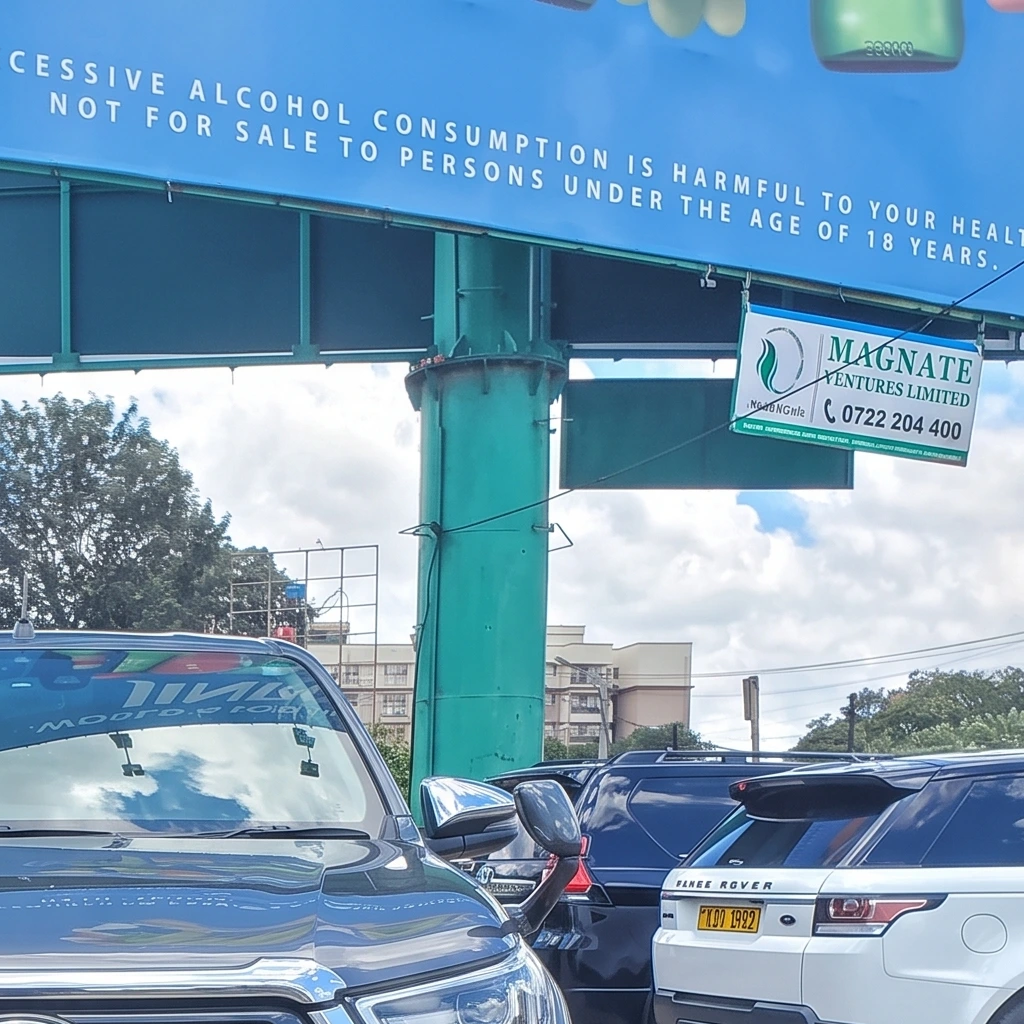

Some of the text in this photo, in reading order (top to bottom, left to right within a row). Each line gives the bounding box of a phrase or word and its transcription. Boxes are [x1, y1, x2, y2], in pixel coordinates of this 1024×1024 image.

[189, 79, 351, 125] ALCOHOL
[373, 109, 608, 170] CONSUMPTION
[628, 154, 654, 178] IS
[673, 162, 805, 207] HARMFUL
[821, 191, 853, 215] TO
[868, 199, 936, 230] YOUR
[50, 91, 998, 271] NOT FOR SALE TO PERSONS UNDER THE AGE OF 18 YEARS.
[827, 335, 973, 385] MAGNATE
[825, 370, 971, 408] VENTURES LIMITED
[842, 404, 962, 441] 0722 204 400
